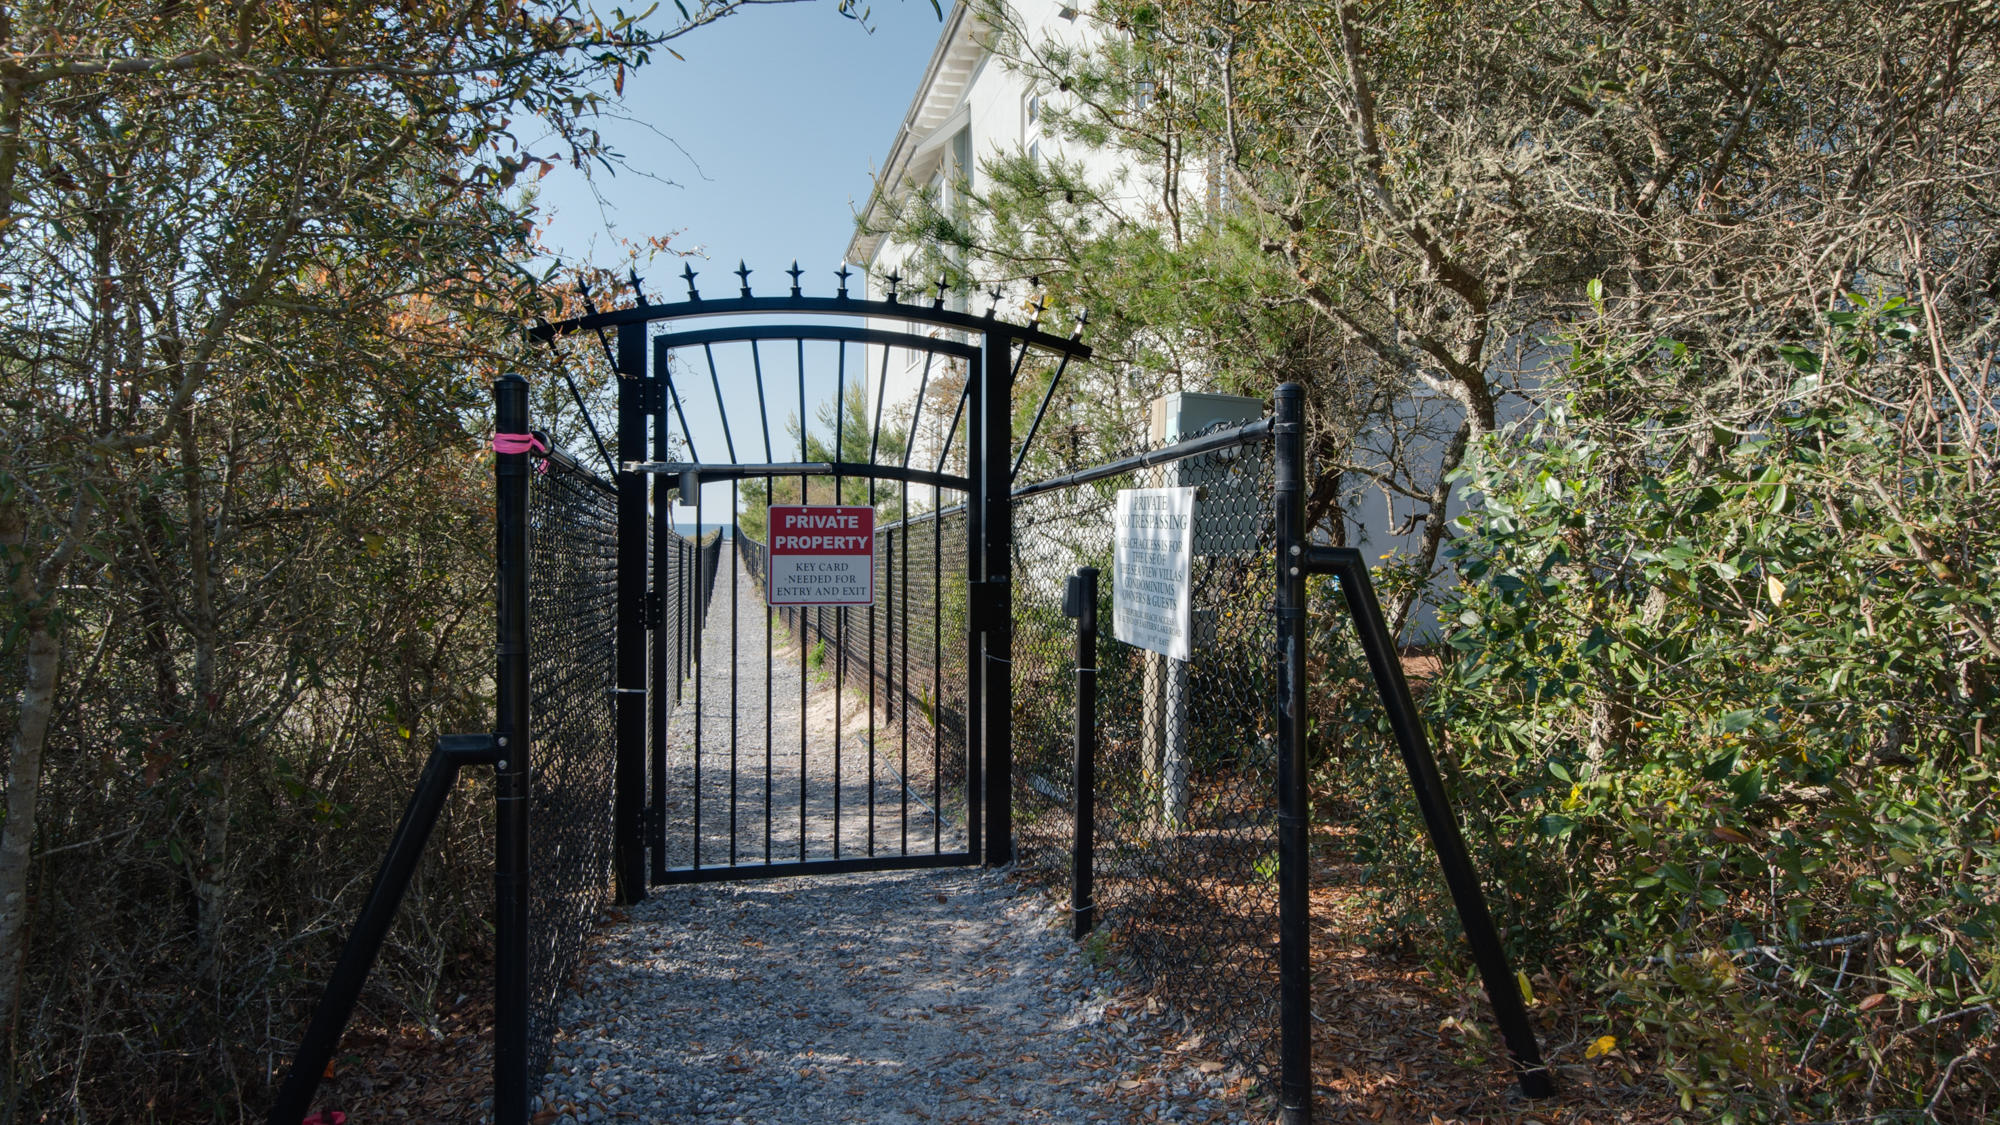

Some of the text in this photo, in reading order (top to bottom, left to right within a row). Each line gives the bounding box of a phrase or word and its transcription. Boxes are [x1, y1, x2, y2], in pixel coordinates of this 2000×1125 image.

[1135, 495, 1168, 510] PRIVATE
[785, 515, 859, 528] PRIVATE
[1120, 513, 1188, 530] NO TRESPASSING
[775, 536, 869, 550] PROPERTY
[1120, 537, 1182, 552] BEACH ACCESS IS FOR
[1132, 551, 1166, 566] THE USE OF
[796, 563, 848, 572] KEY CARD
[1141, 566, 1157, 578] VIEW
[1159, 567, 1182, 582] VILLAS
[788, 575, 856, 584] NEEDED FOR
[1125, 576, 1174, 596] CONDOMINIUMS
[776, 587, 866, 596] ENTRY AND EXIT
[1122, 590, 1146, 604] OWNERS
[1152, 594, 1176, 610] GUESTS
